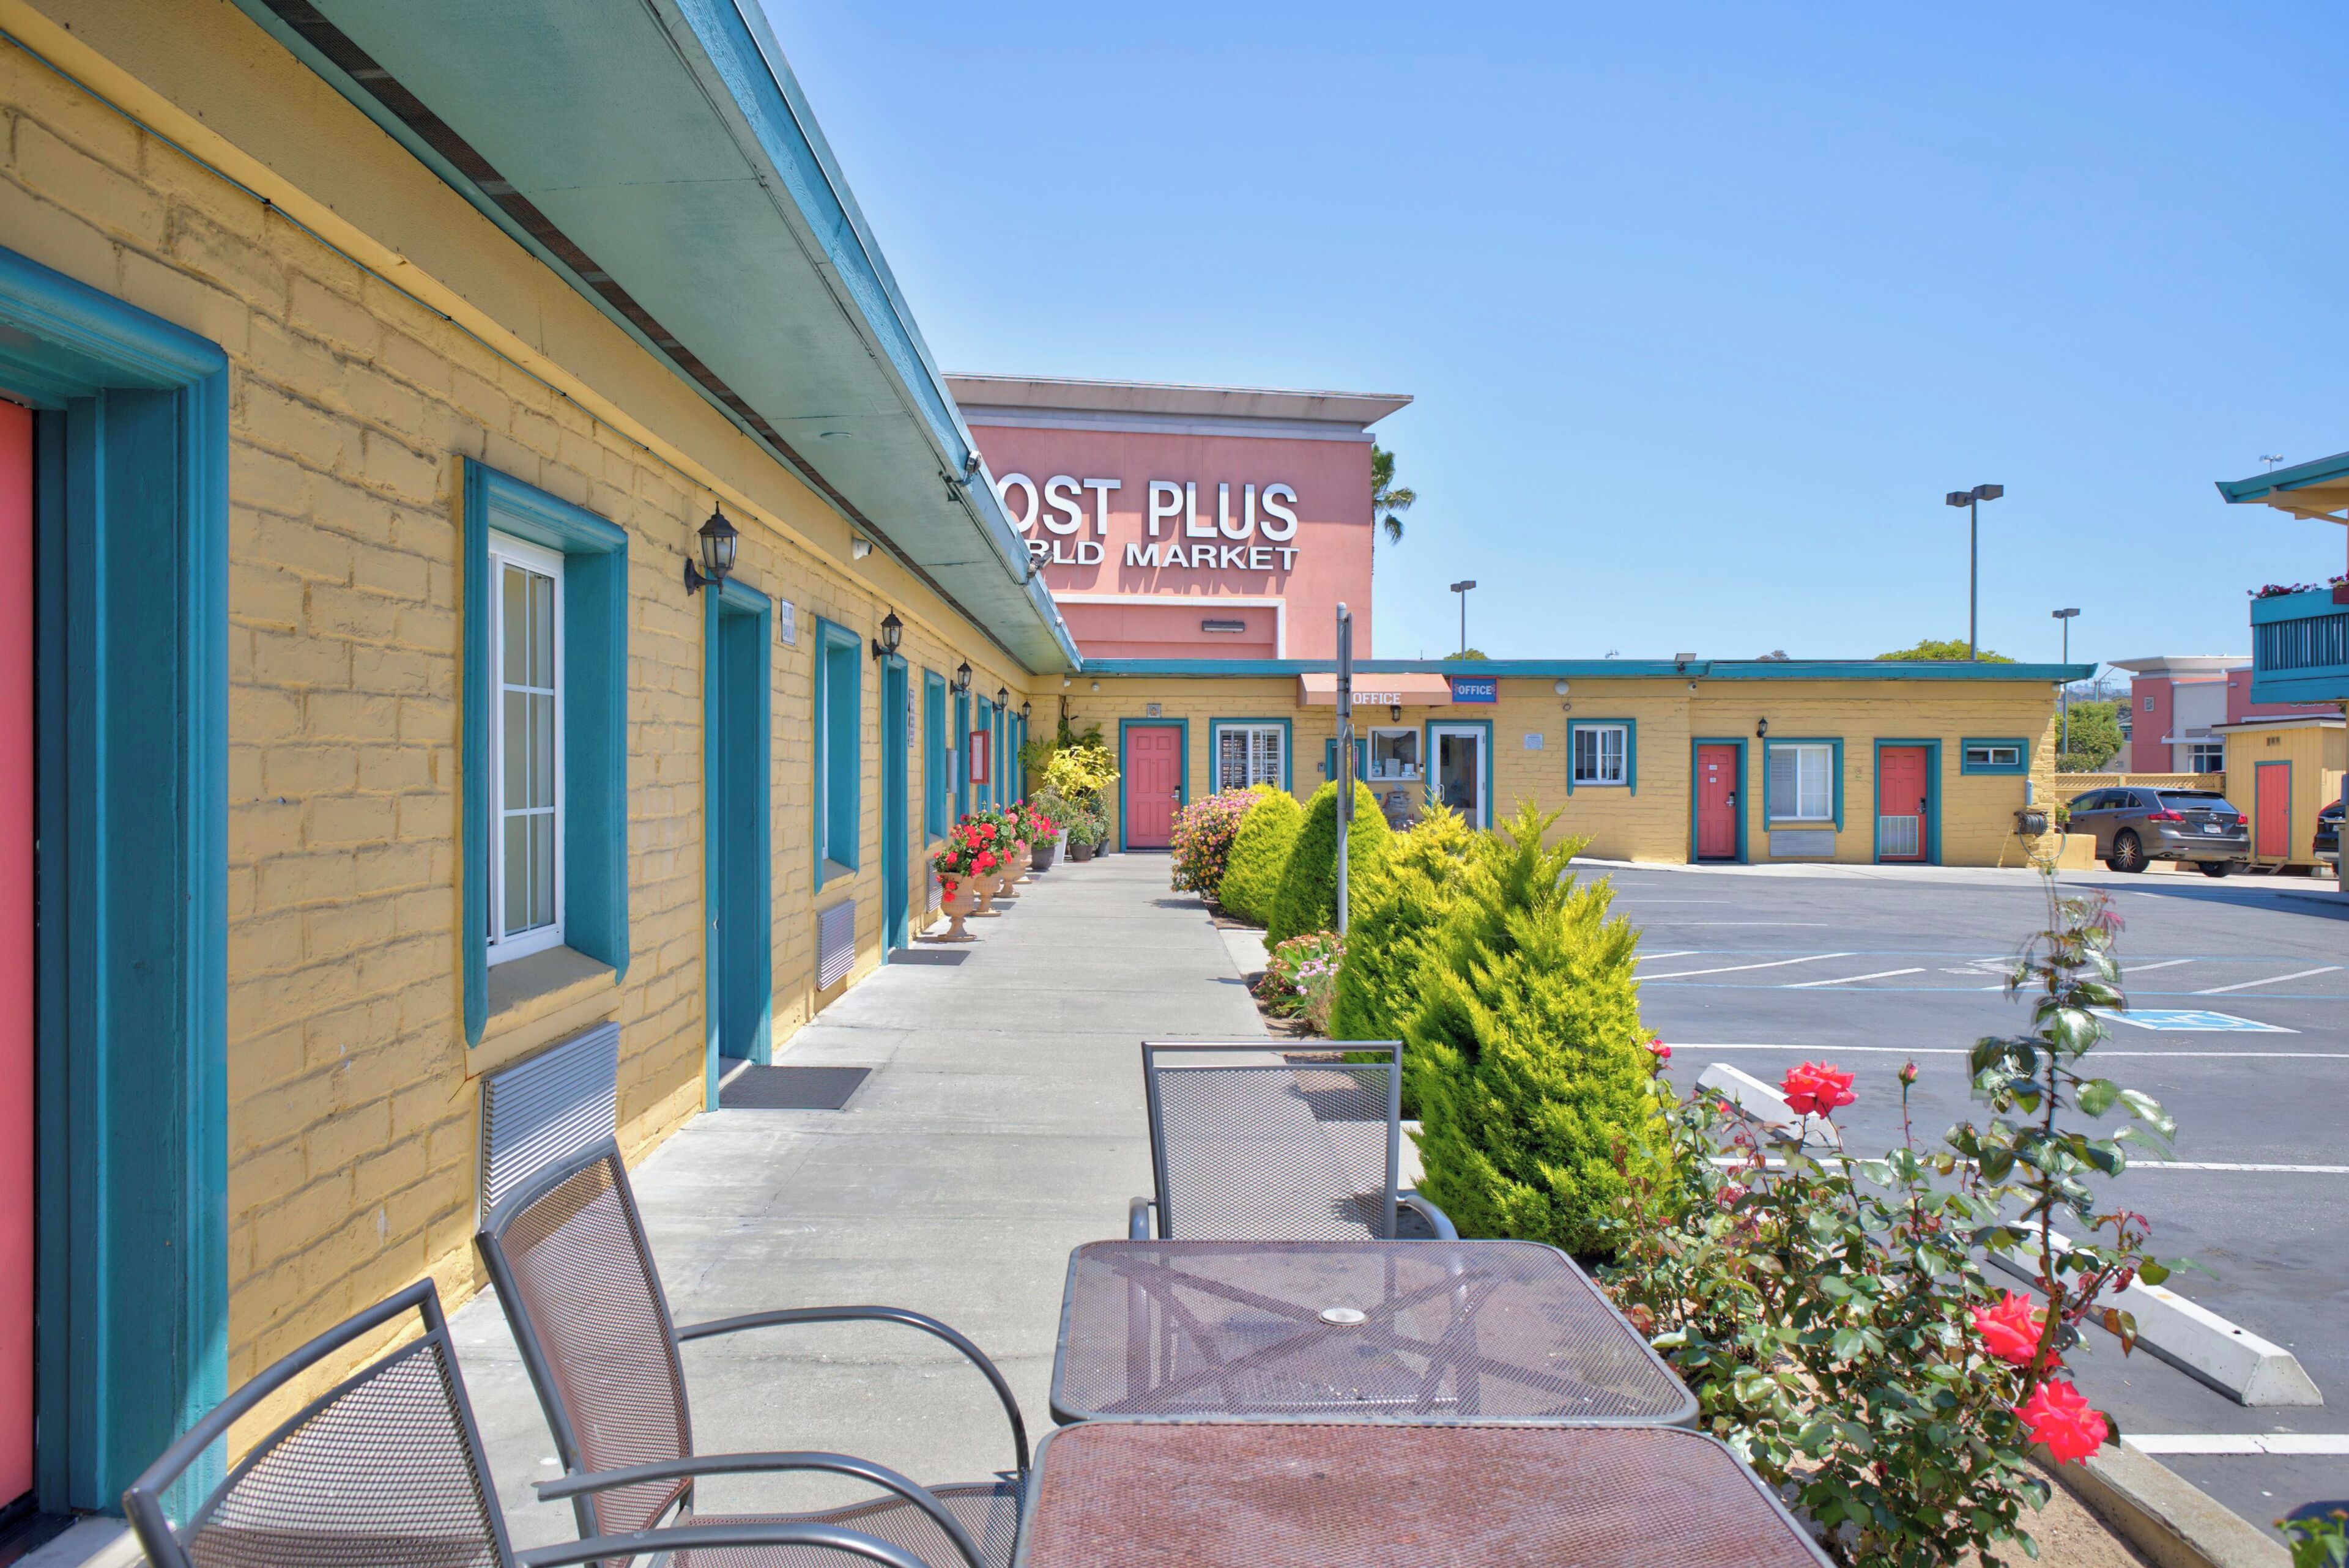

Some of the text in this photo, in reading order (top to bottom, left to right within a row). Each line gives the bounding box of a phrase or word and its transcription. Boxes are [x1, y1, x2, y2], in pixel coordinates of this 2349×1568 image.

[996, 473, 1298, 541] OST PLUS
[1126, 542, 1300, 570] MARKET
[1353, 692, 1401, 704] OFFICE
[1458, 685, 1492, 695] OFFICE
